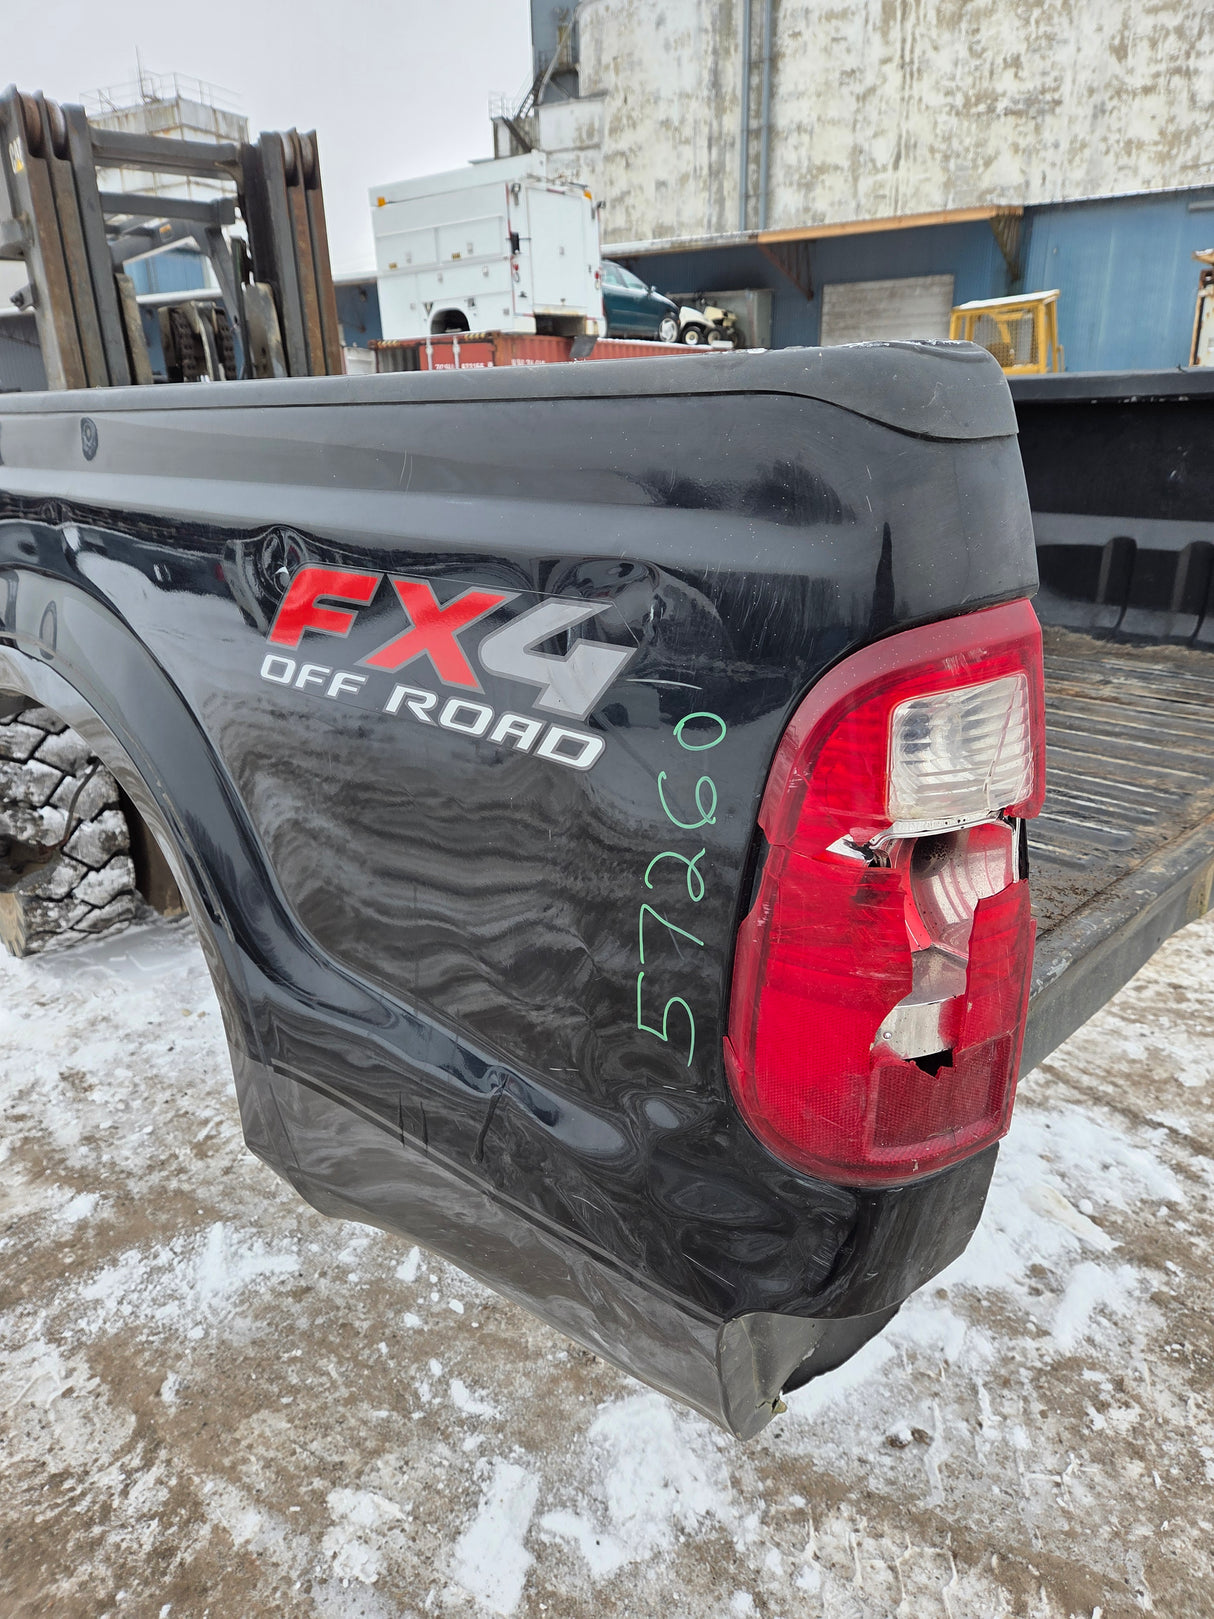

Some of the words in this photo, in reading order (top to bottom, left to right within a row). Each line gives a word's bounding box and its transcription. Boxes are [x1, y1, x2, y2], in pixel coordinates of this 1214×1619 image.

[260, 653, 367, 700] OFF
[383, 684, 606, 771] ROAD
[266, 563, 637, 718] FX4
[637, 711, 727, 1067] 57260
